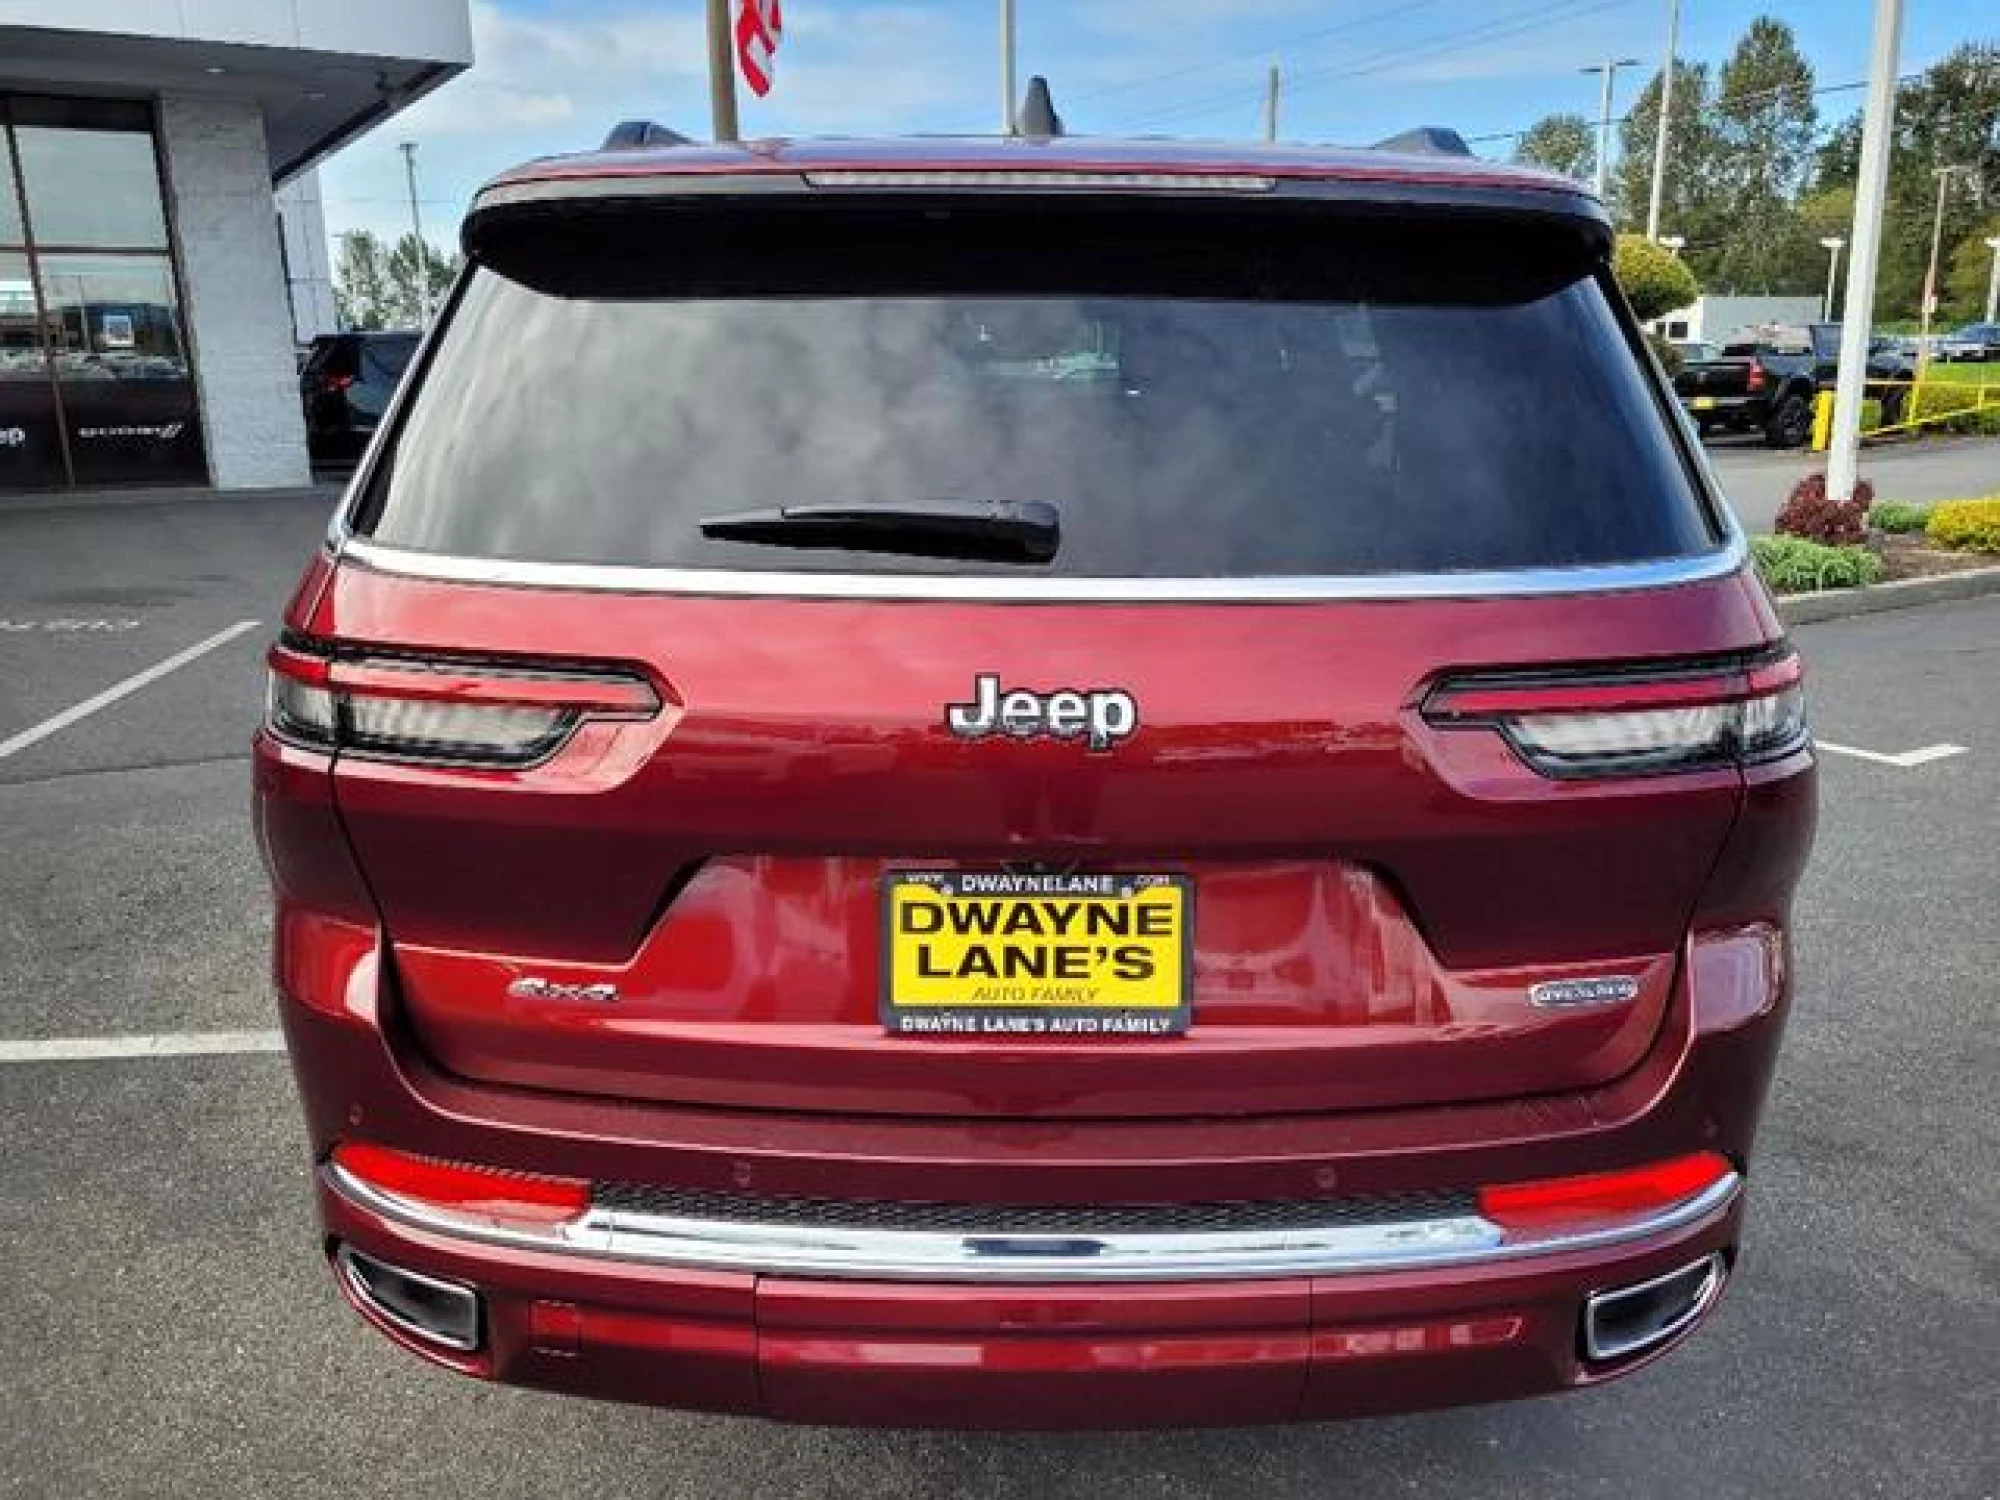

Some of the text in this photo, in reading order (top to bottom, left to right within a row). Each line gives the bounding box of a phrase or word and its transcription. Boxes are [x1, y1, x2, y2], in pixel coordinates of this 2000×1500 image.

[946, 674, 1137, 751] Jeep
[900, 902, 1173, 935] DWAYNE
[918, 944, 1155, 981] LANE'S
[971, 986, 1100, 1001] AUTO FAMILY
[902, 1015, 976, 1032] DWAYNE
[1050, 1015, 1097, 1032] AUTO
[1102, 1015, 1171, 1032] FAMILY
